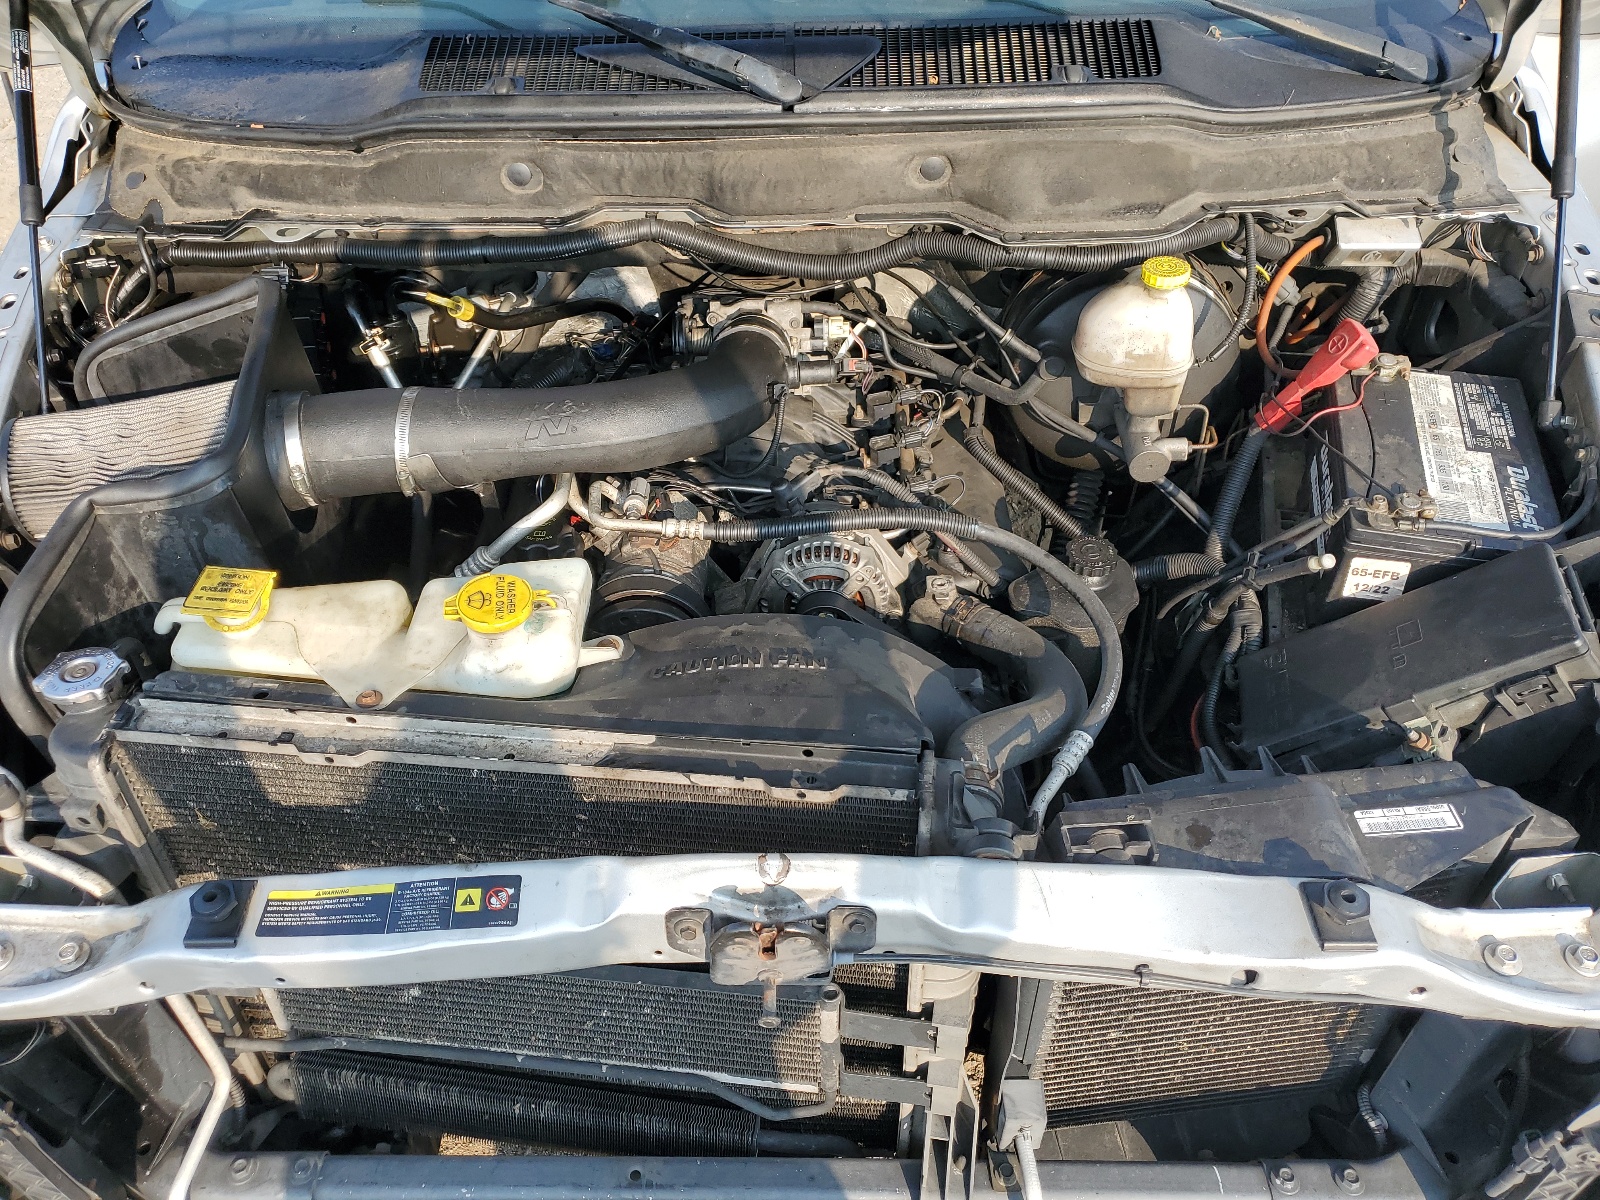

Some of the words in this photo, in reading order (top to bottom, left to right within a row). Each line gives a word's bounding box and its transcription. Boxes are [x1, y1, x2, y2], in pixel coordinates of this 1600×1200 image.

[1503, 486, 1521, 527] PLATINUM
[1506, 465, 1545, 532] Duralast
[1351, 567, 1400, 581] 65-EFB
[496, 576, 505, 599] FLUID
[507, 580, 516, 614] WASHER
[1353, 582, 1391, 595] 12/22
[495, 600, 505, 620] ONLY
[652, 648, 764, 679] CAUTION
[769, 649, 827, 670] FAN
[410, 880, 439, 888] ATTENTION
